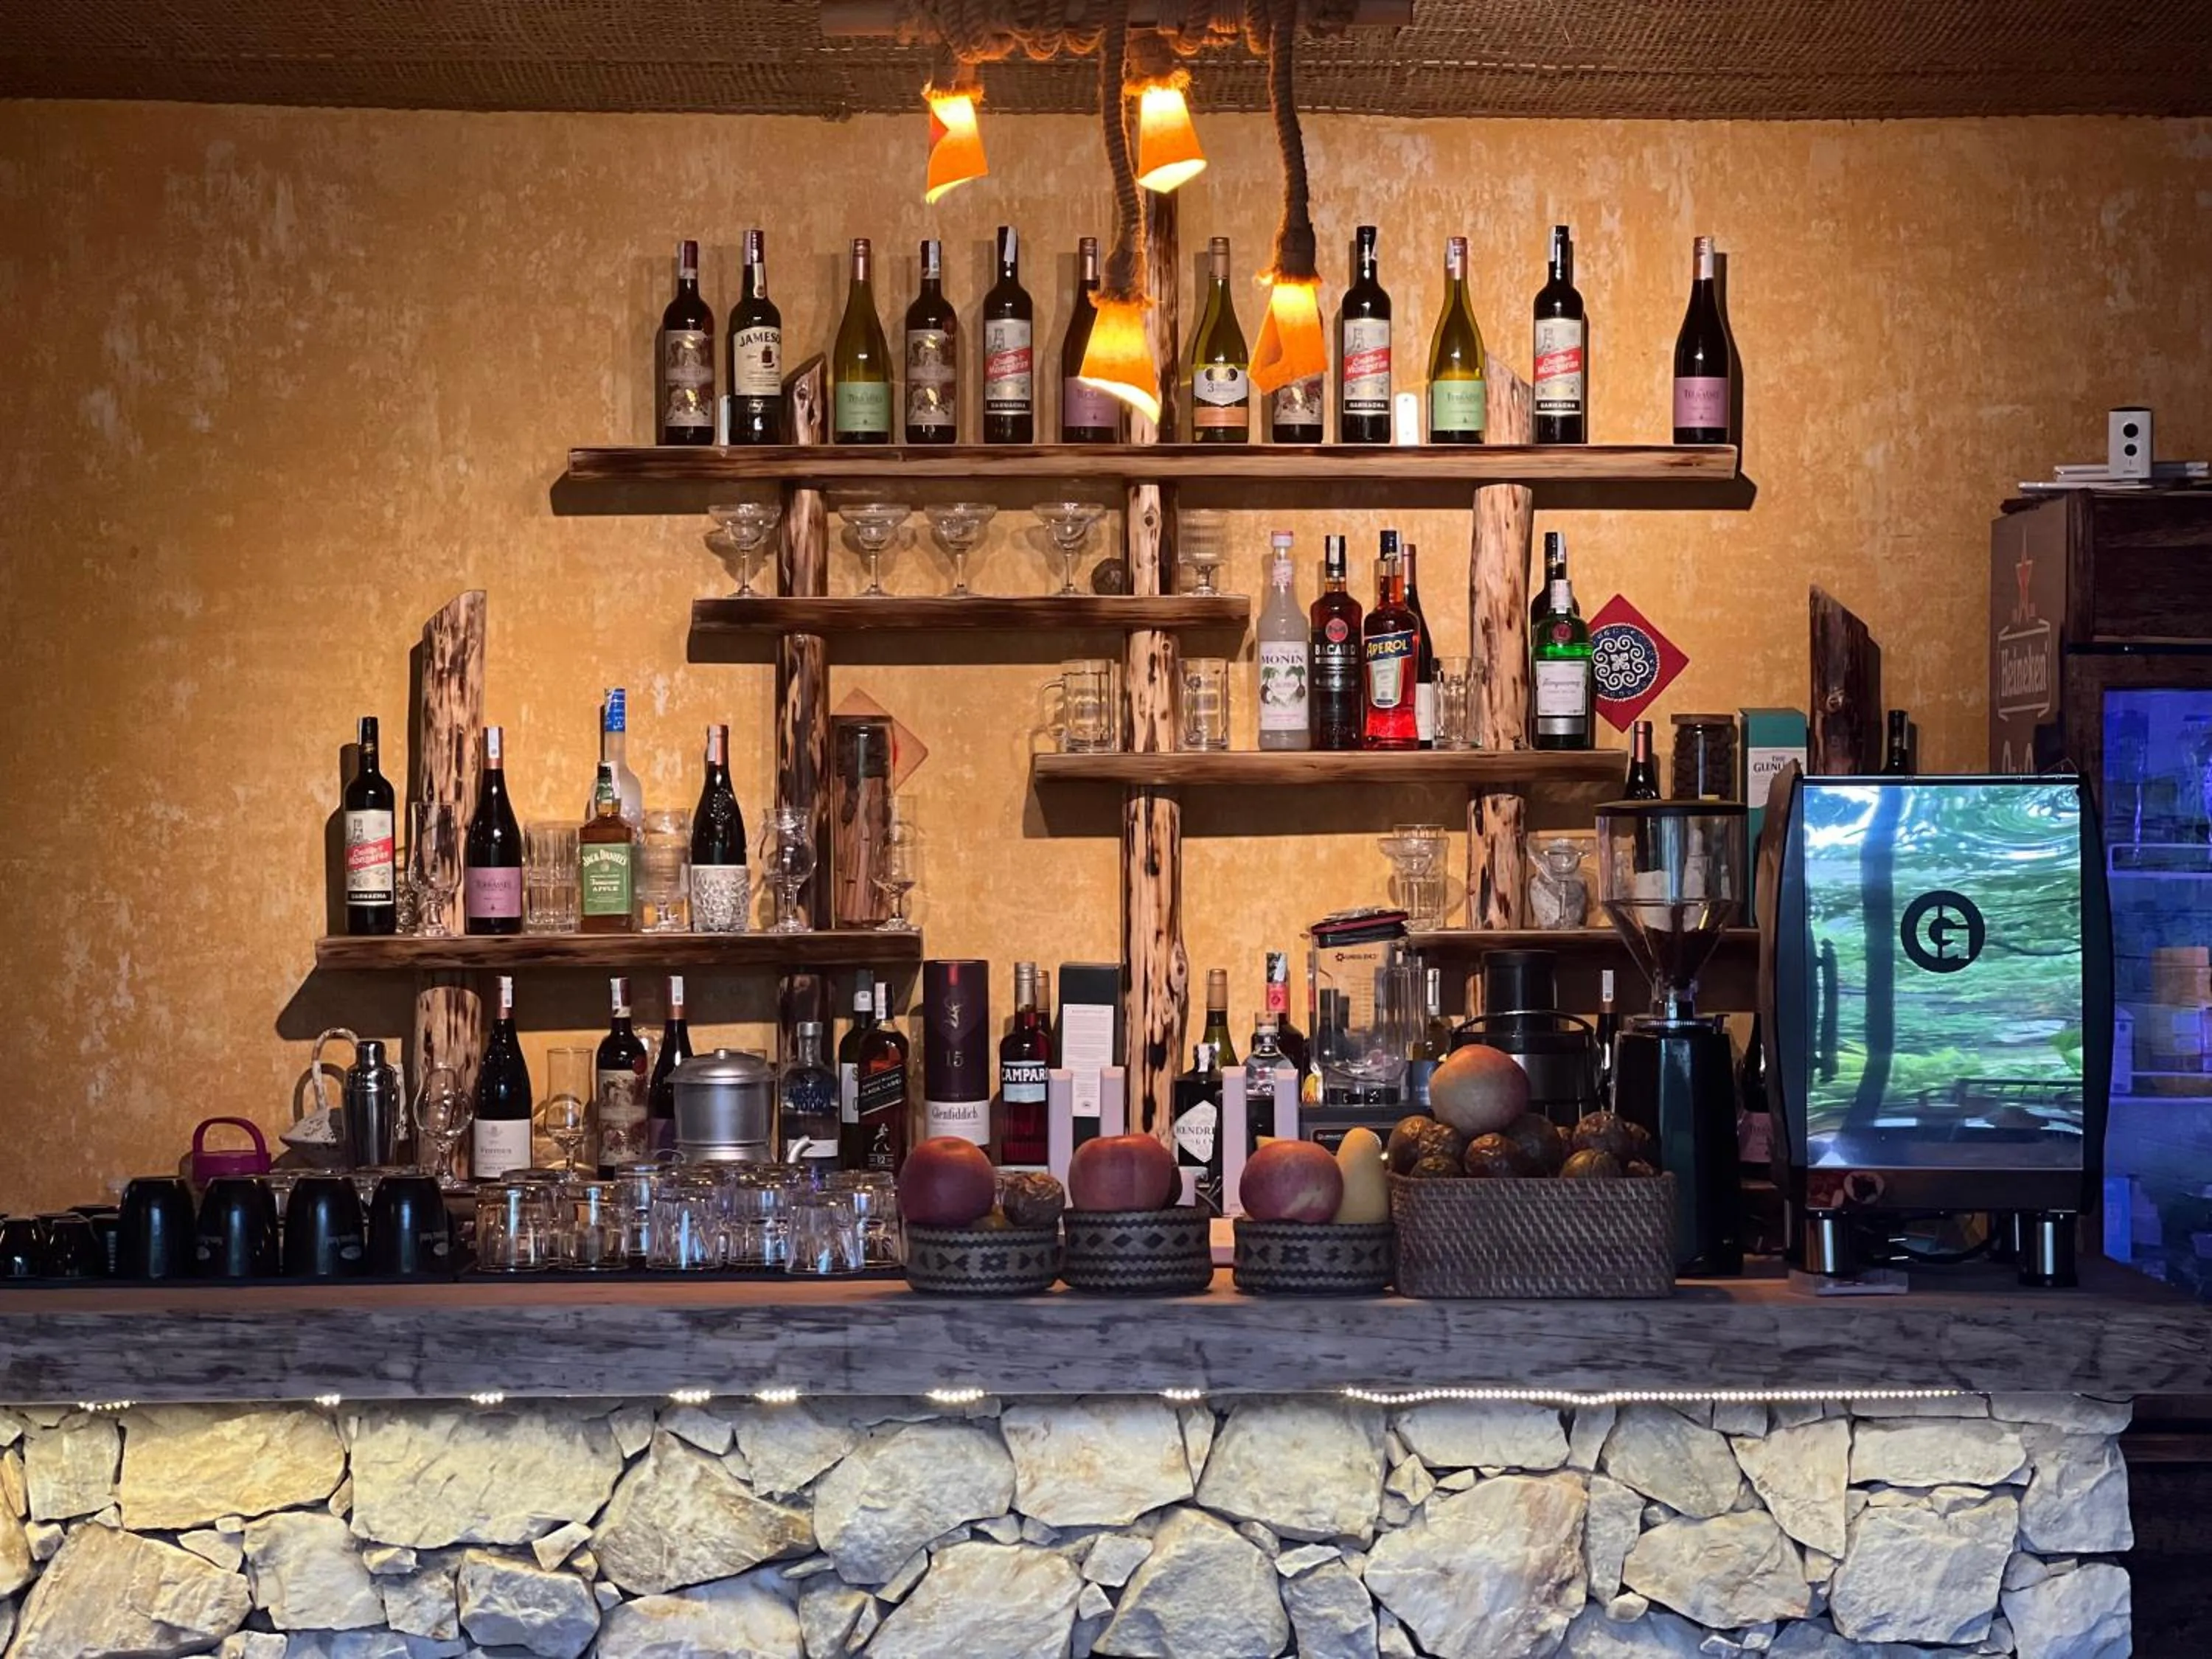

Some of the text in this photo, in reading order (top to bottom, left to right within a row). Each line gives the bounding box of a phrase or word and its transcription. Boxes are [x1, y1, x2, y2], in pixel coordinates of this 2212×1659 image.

[1367, 639, 1408, 656] APEROL
[1261, 654, 1304, 664] MONIN
[945, 1051, 963, 1068] 15
[931, 1107, 978, 1121] Glenfiddich
